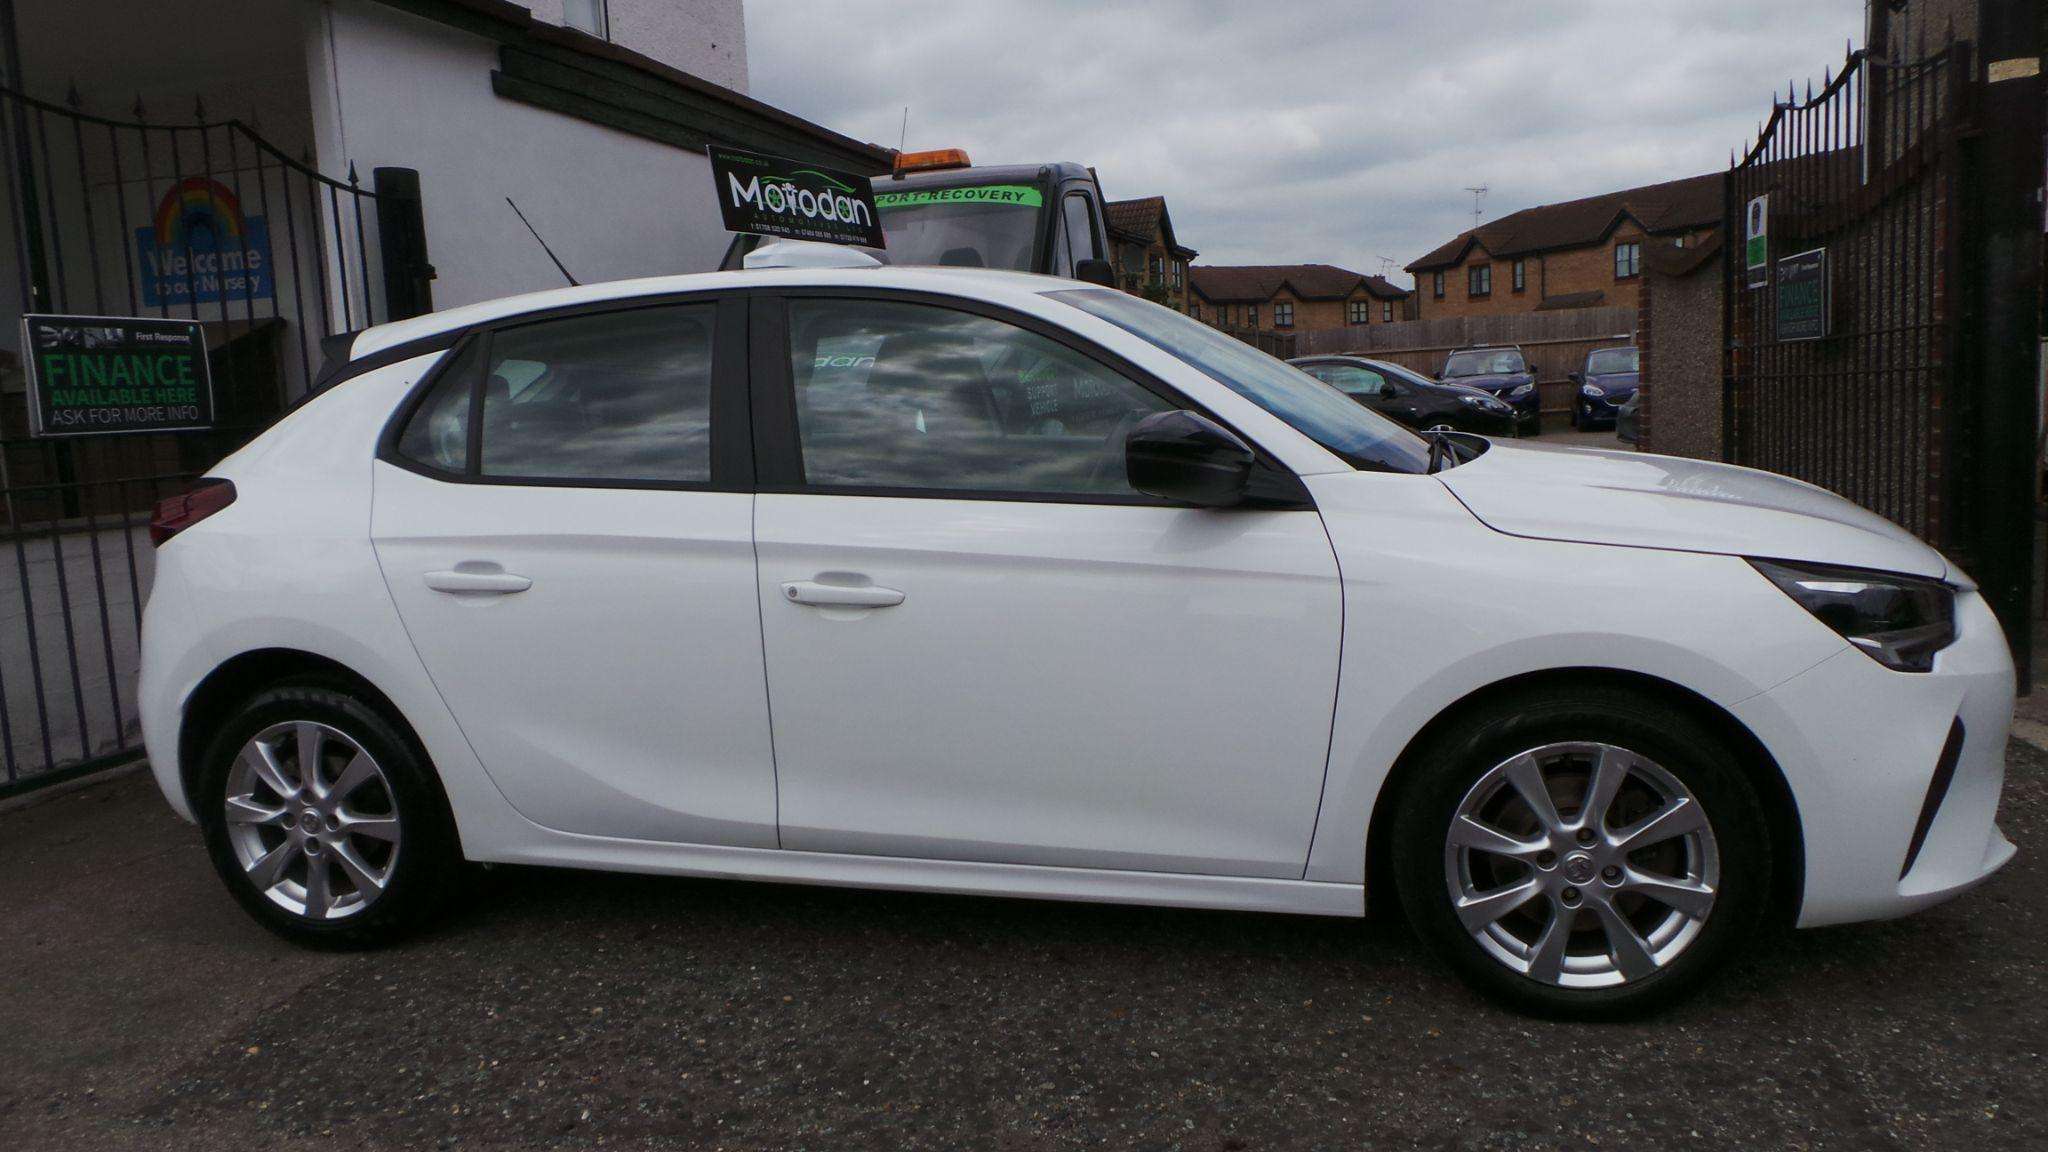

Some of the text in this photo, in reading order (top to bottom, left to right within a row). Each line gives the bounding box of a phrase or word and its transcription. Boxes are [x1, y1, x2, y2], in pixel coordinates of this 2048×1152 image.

[44, 354, 195, 386] FINANCE
[52, 387, 197, 406] AVAILABLE HERE
[52, 405, 199, 425] ASK FOR MORE INFO
